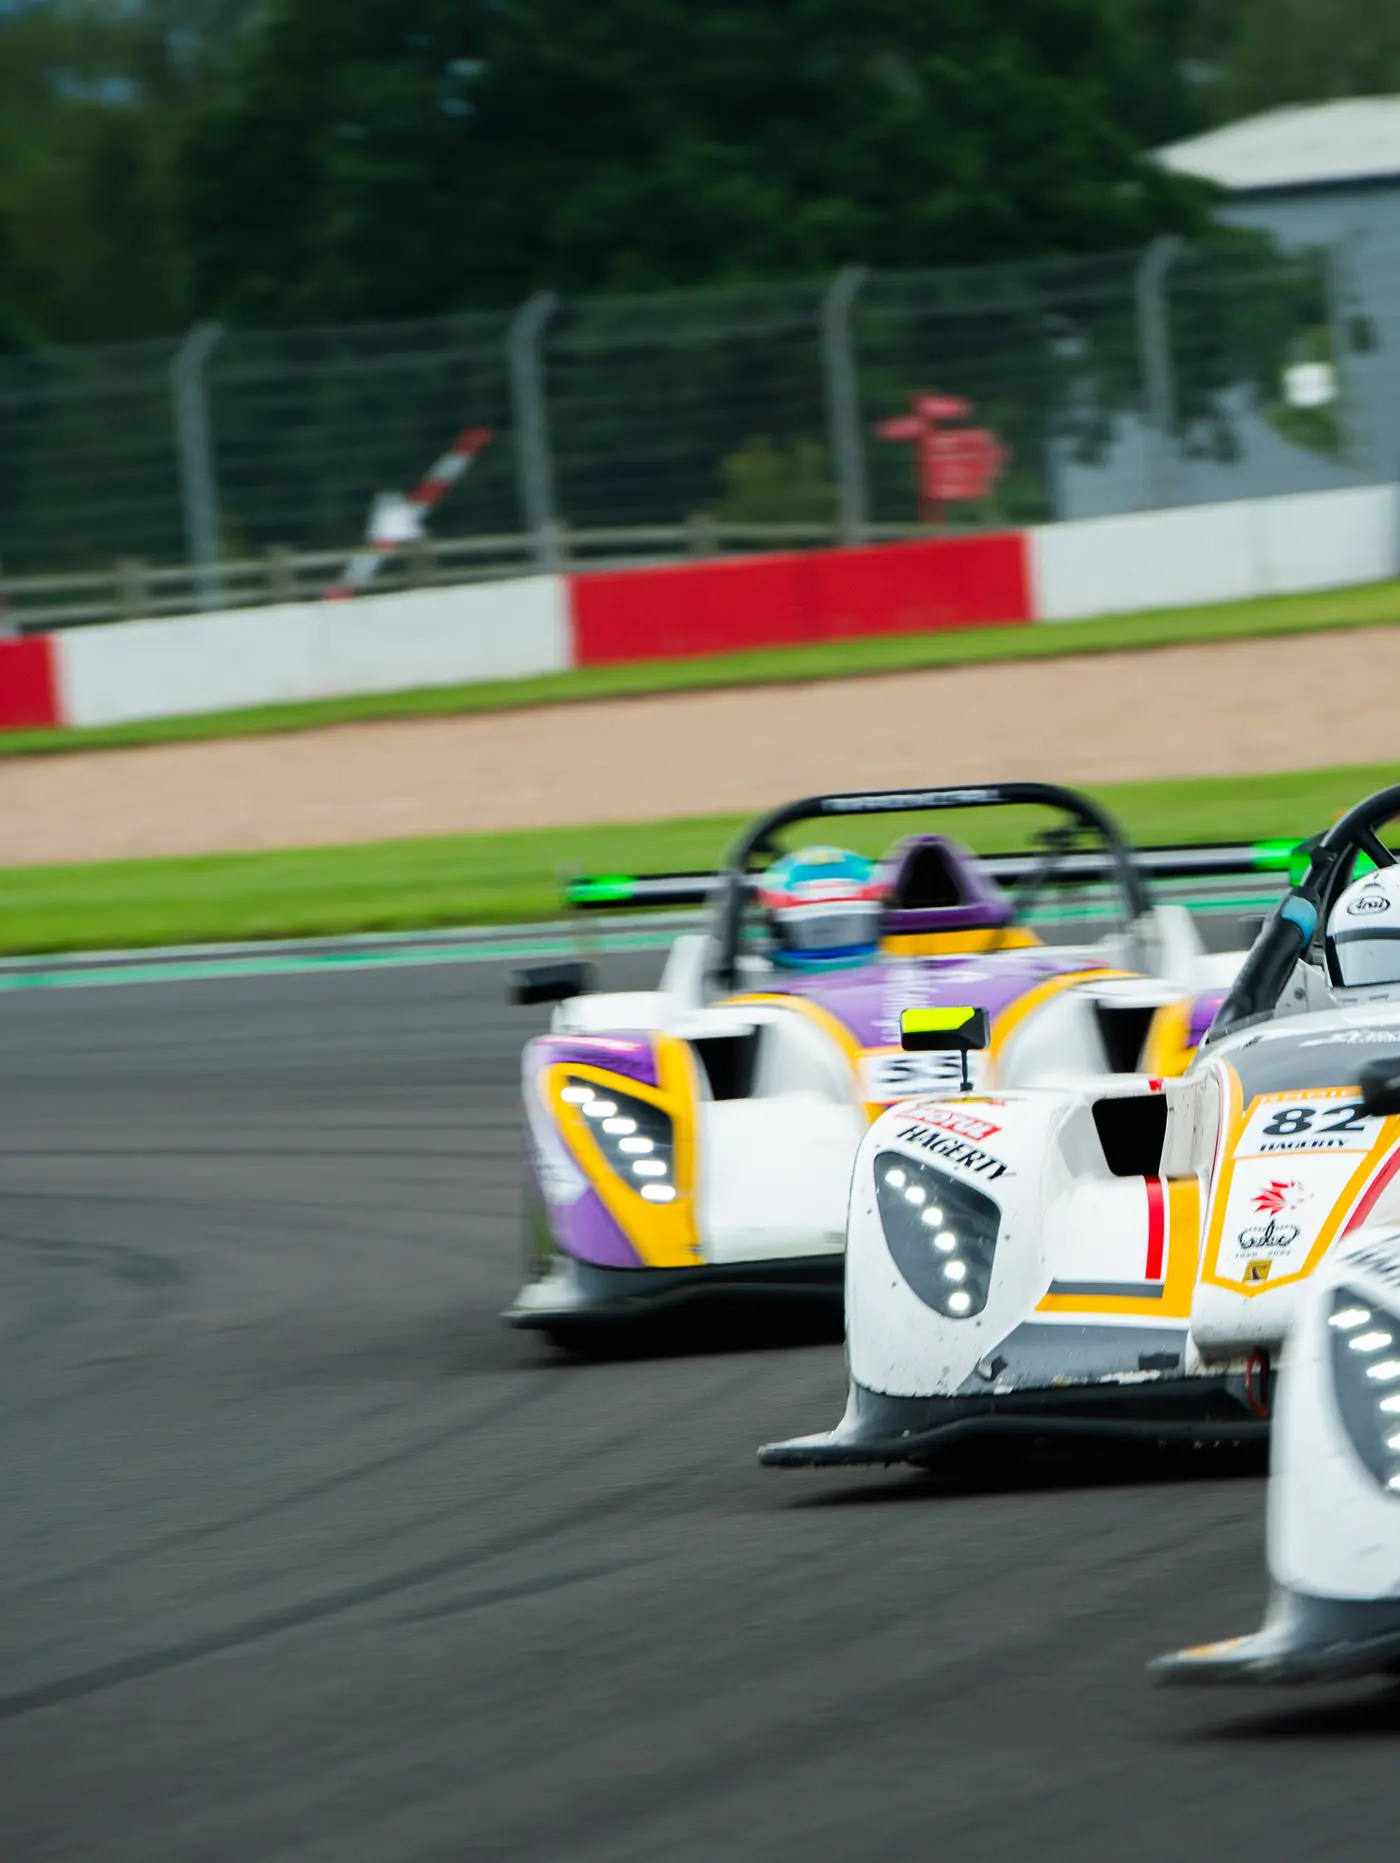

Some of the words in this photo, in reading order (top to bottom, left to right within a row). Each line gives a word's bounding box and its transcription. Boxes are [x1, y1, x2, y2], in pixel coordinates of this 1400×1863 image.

[1262, 1102, 1370, 1136] 82
[896, 1124, 1007, 1180] HAGERTY
[1259, 1138, 1349, 1152] HAGERTY
